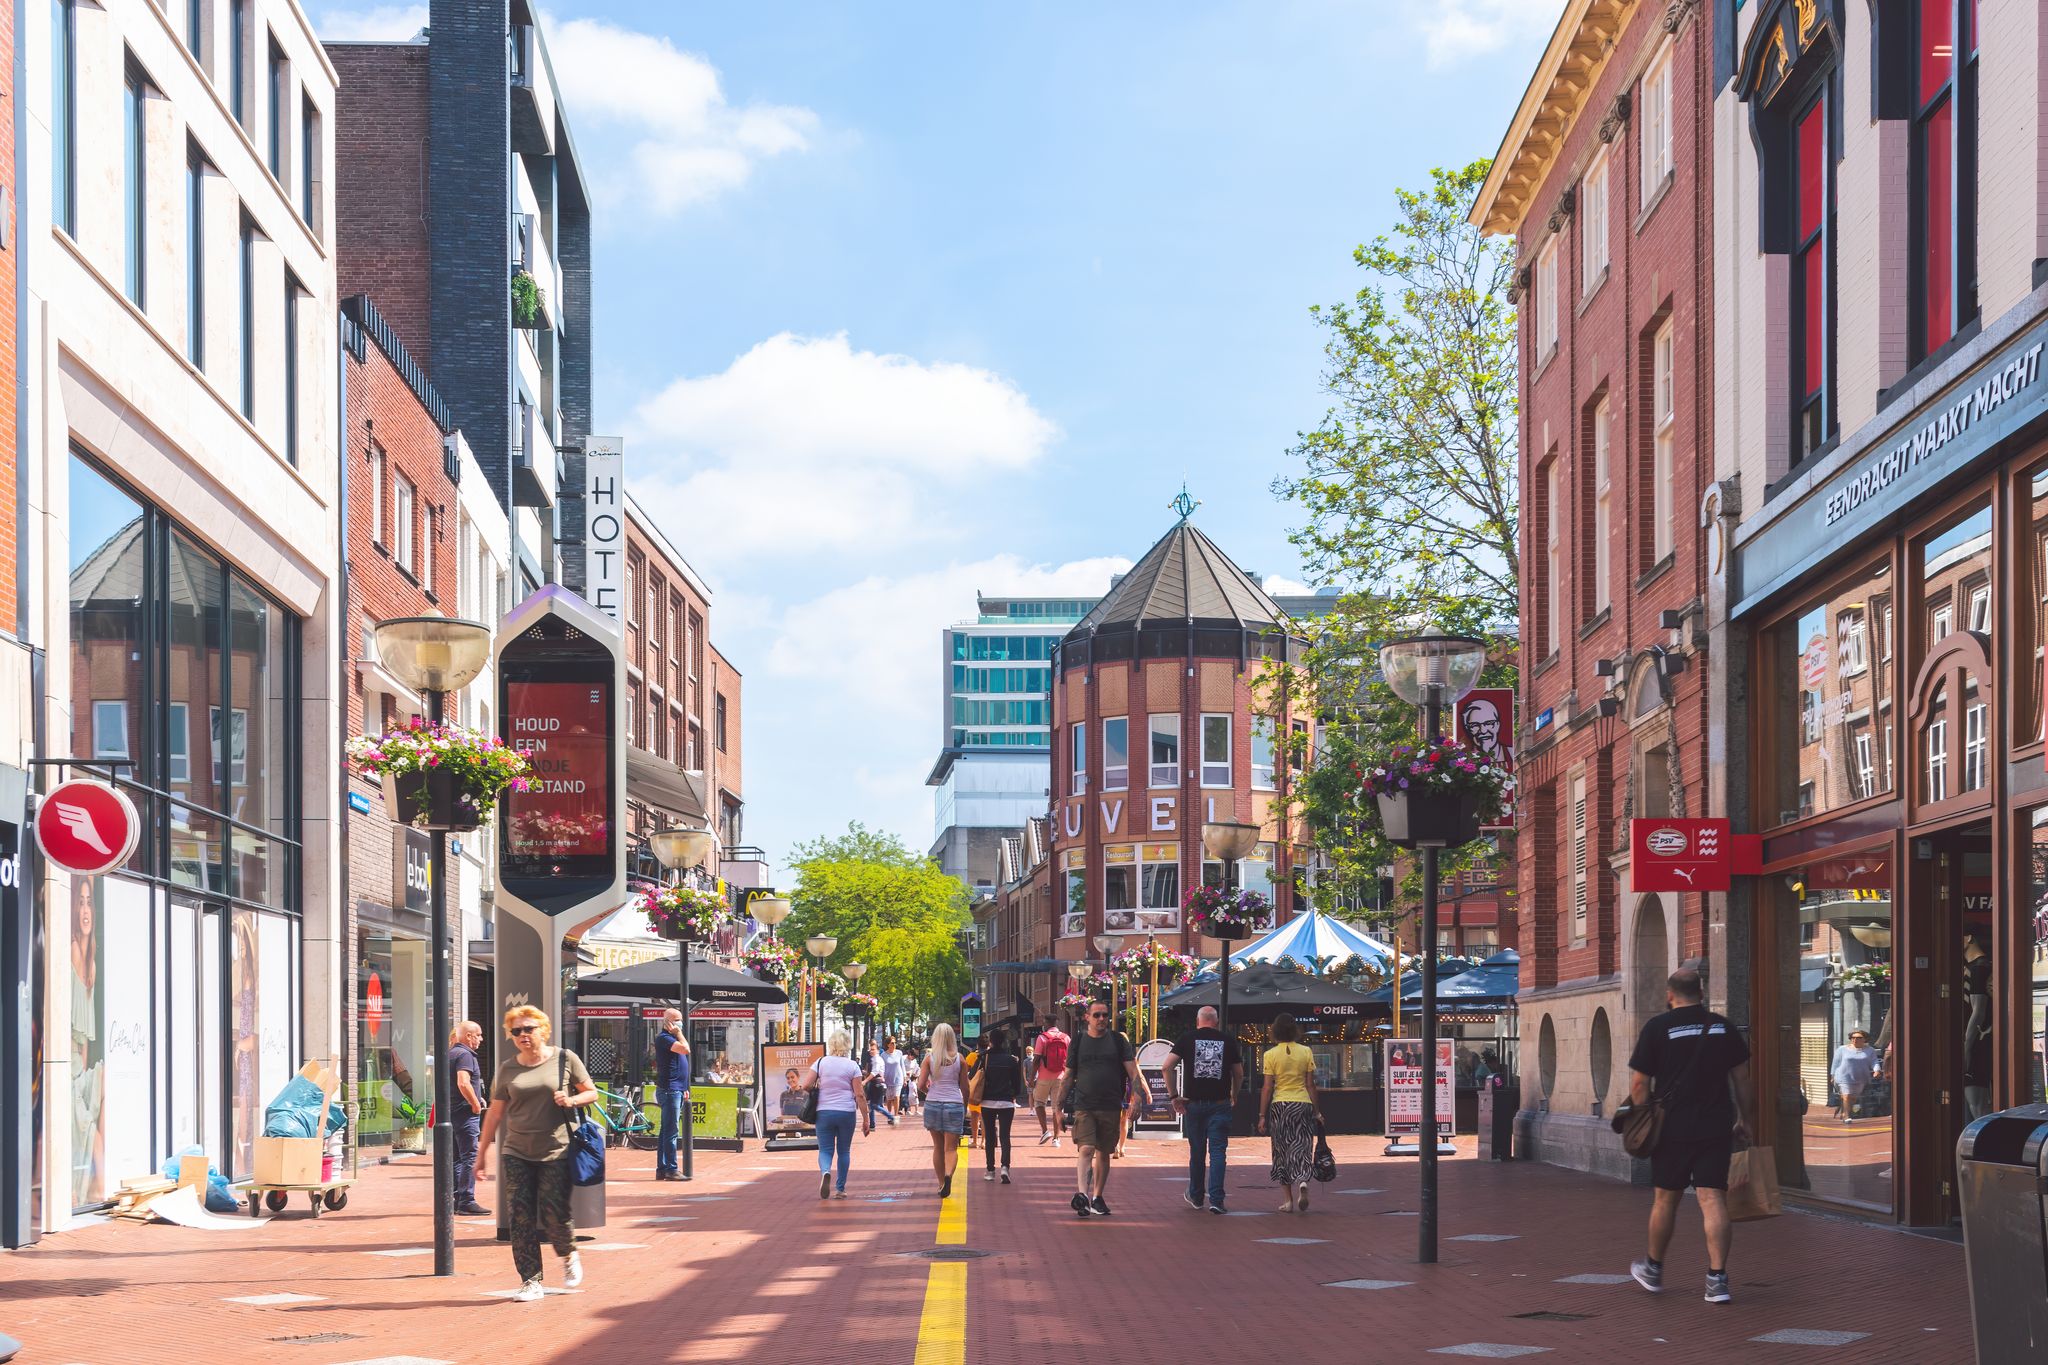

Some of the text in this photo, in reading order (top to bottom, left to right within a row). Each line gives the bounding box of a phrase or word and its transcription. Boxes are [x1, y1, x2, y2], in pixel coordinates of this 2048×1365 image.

[1825, 343, 2044, 526] EENDRACHT MAAKT MACHT
[591, 476, 620, 617] HOTE
[515, 718, 560, 731] HOUD
[515, 739, 547, 751] EEN
[515, 780, 586, 794] STAND
[1251, 847, 1267, 860] City
[1964, 896, 1994, 909] V FA
[367, 995, 383, 1011] SALE
[1322, 1005, 1358, 1015] OMER.
[776, 1049, 811, 1058] FULLTIMERS
[780, 1058, 808, 1066] GEZOCHT!
